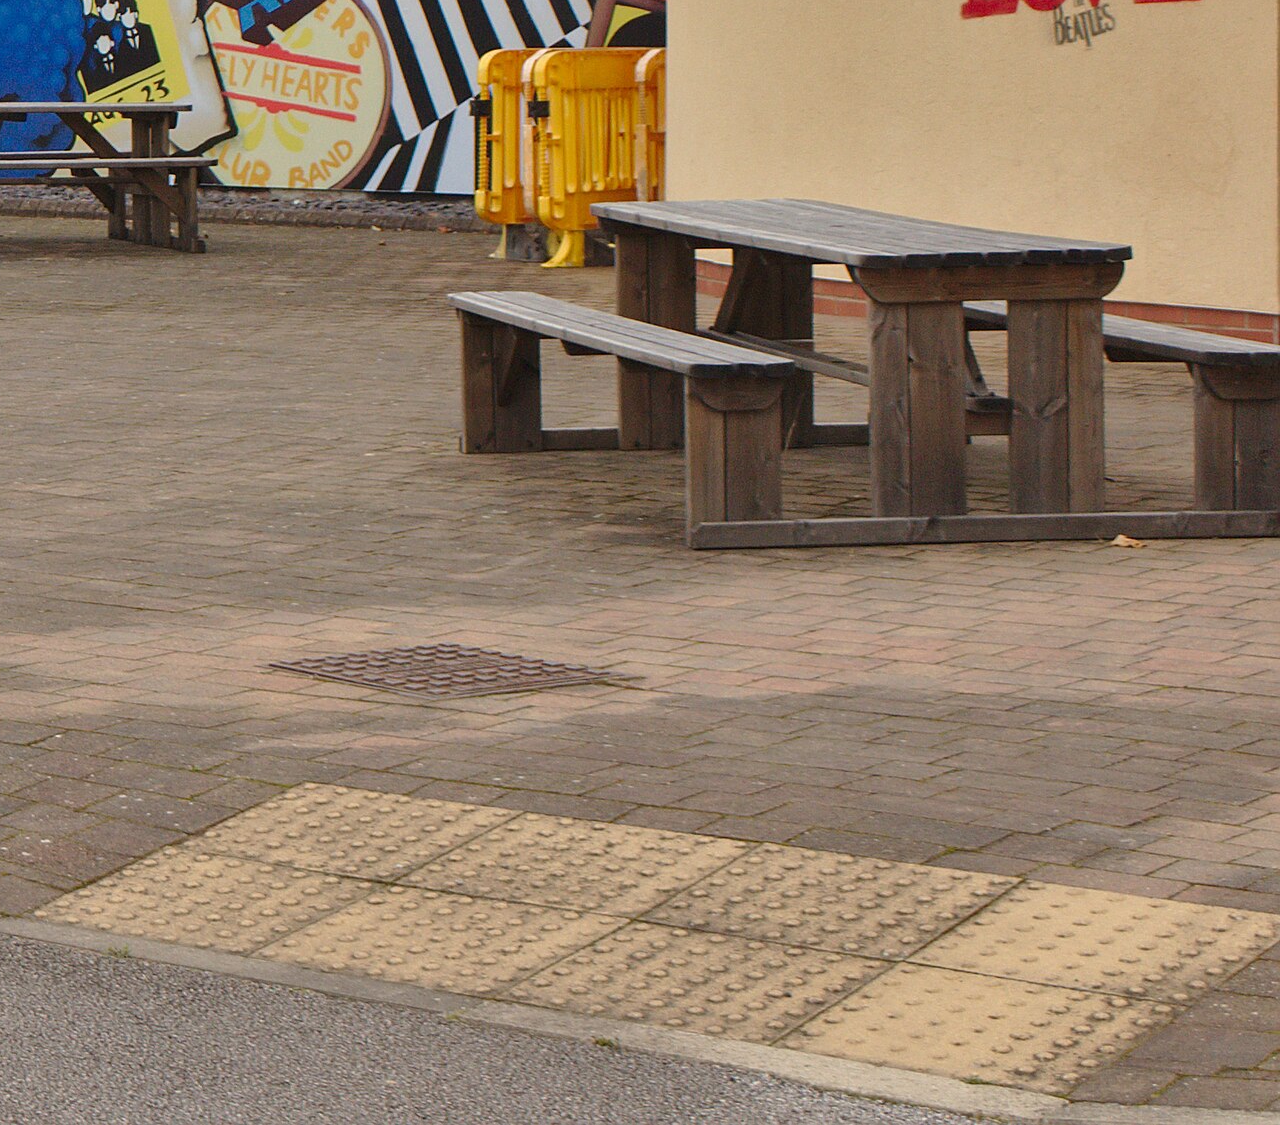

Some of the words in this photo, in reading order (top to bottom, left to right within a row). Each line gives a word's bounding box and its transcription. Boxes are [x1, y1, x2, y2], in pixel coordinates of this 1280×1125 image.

[1053, 3, 1116, 48] BEATLES
[140, 77, 171, 103] 23
[260, 62, 363, 111] HEARTS
[208, 143, 272, 188] LUB
[288, 139, 354, 189] BAND
